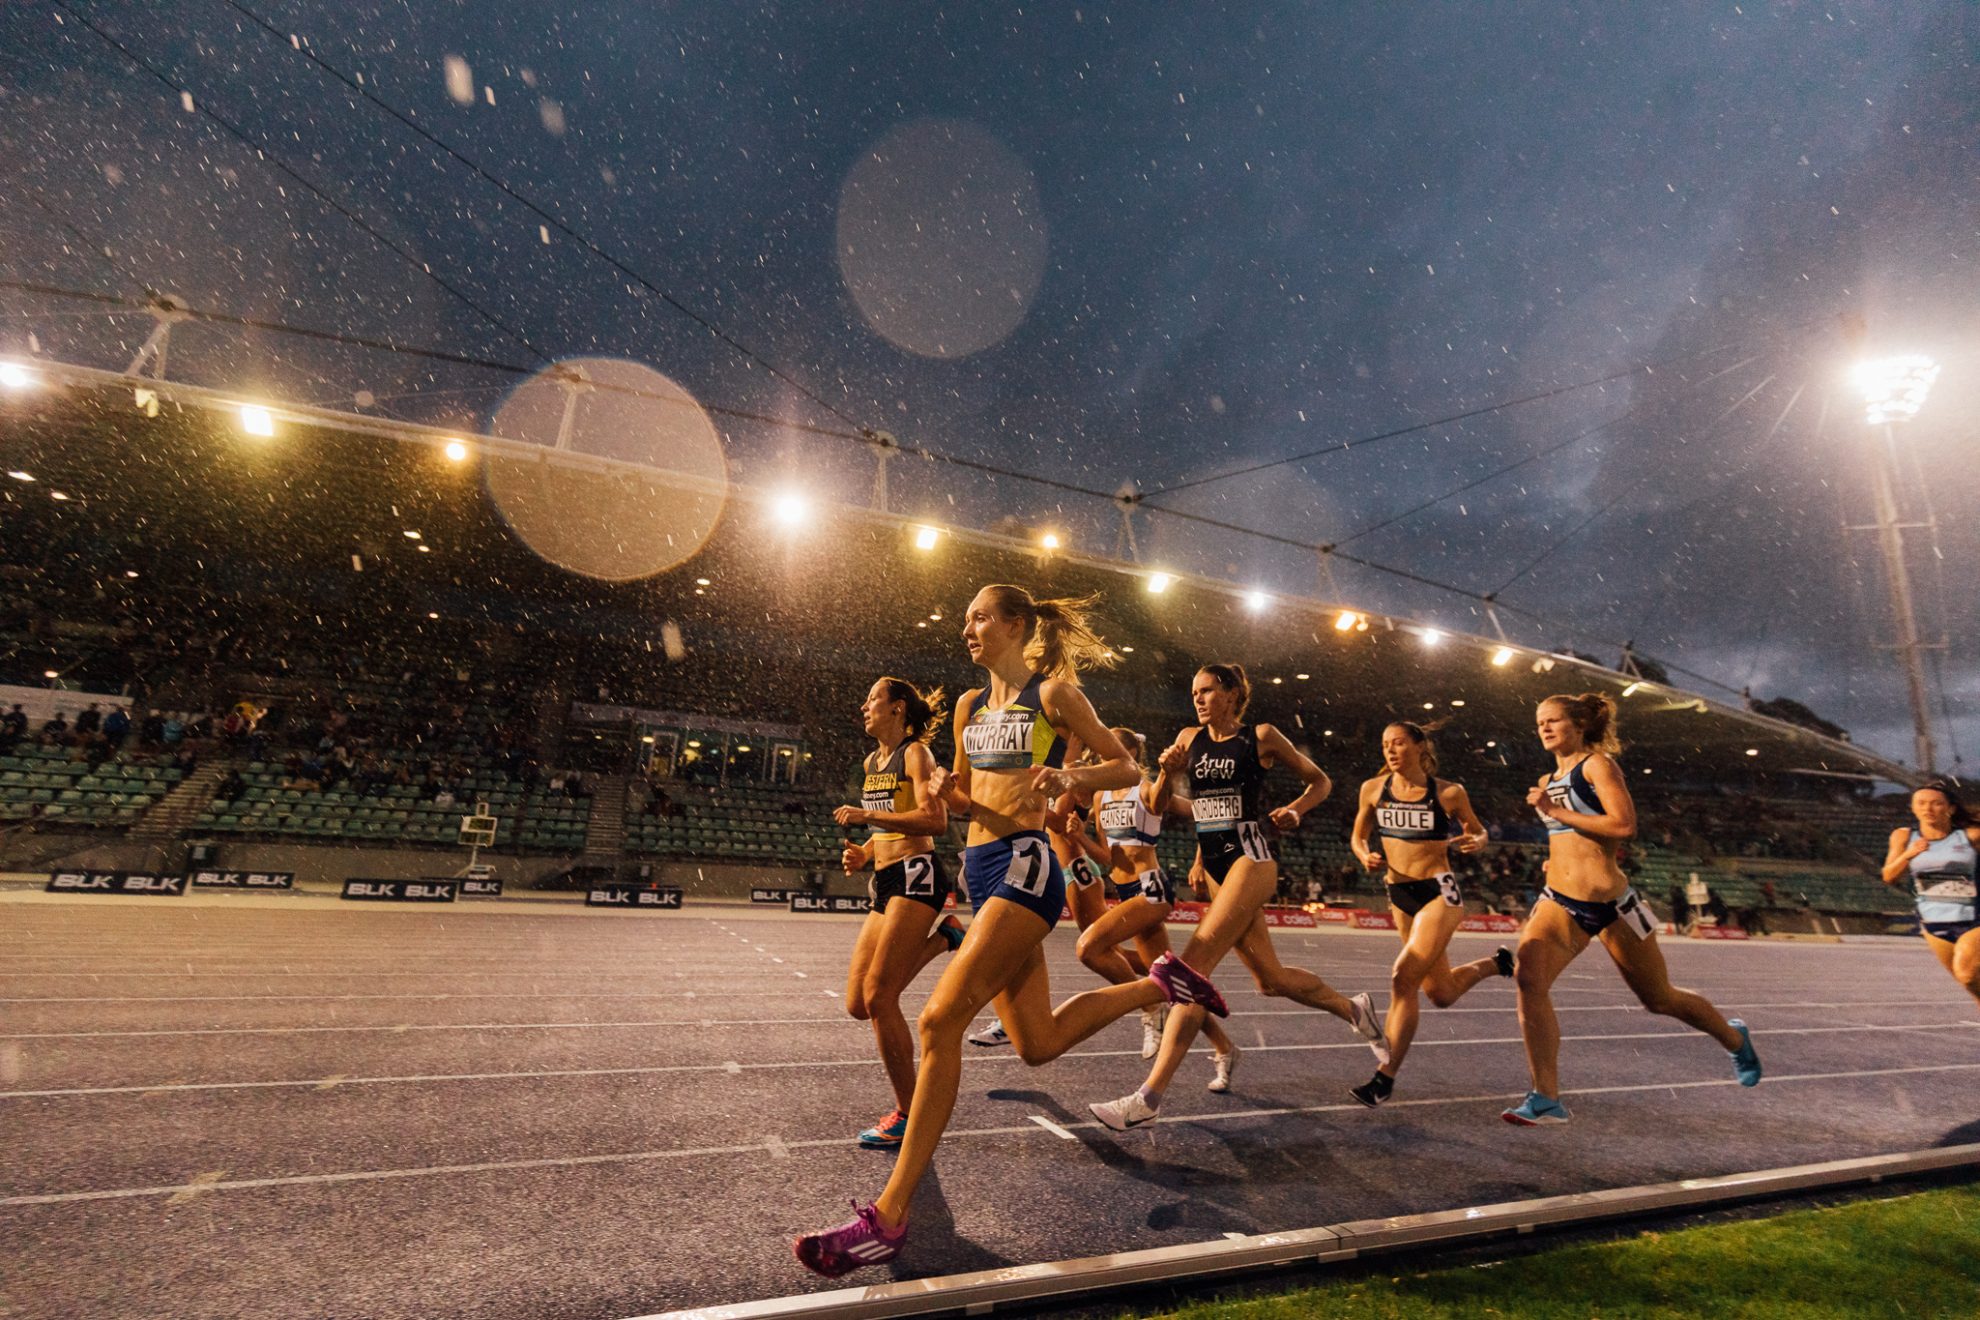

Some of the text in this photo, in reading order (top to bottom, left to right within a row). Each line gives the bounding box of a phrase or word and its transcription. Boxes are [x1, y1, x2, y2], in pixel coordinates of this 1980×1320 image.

[966, 723, 1031, 752] MURRAY
[1208, 758, 1236, 769] run
[1195, 767, 1235, 779] crew
[1101, 810, 1134, 826] HANSEN
[1383, 810, 1430, 829] RULE
[907, 856, 932, 893] 2
[1019, 841, 1043, 892] 1
[1071, 857, 1094, 886] 6
[53, 873, 182, 891] BLK BLK
[196, 872, 288, 886] BLK BLK
[1144, 870, 1164, 903] 4
[347, 882, 451, 898] BLK BLK
[463, 882, 499, 893] BLK
[753, 890, 781, 901] BLK
[1442, 874, 1461, 906] 3
[590, 890, 677, 905] BLK BLK
[794, 898, 869, 910] BLK BLK
[1283, 913, 1314, 925] coles
[1359, 915, 1390, 928] coles
[1618, 894, 1653, 934] 7
